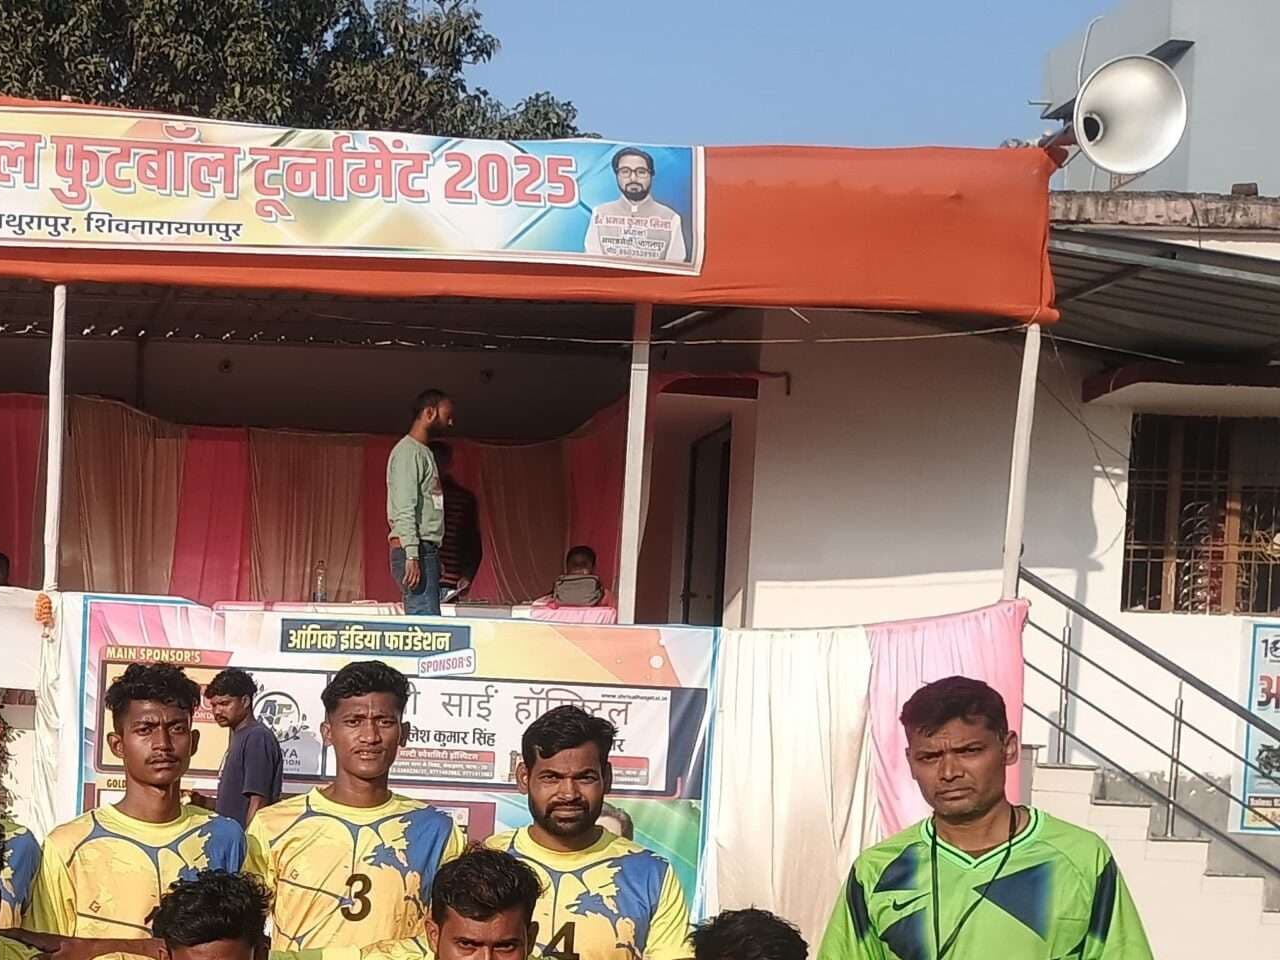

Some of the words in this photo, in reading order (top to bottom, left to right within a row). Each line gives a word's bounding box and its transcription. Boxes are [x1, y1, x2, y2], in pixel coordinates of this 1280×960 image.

[50, 124, 242, 206] फुटबॉल
[249, 134, 431, 218] टूर्नामेंट
[443, 151, 577, 205] 2025
[84, 212, 244, 241] शिवनारायणपुर
[288, 625, 337, 649] आंगिक
[338, 625, 382, 651] इंडिया
[384, 626, 452, 652] फाउंडेशन
[106, 646, 137, 661] MAIN
[139, 648, 202, 663] SPONSOR'S
[420, 655, 473, 674] SPONSOR'S
[440, 684, 499, 722] साईं
[433, 729, 469, 747] कुमार
[472, 727, 497, 747] सिंह
[340, 873, 372, 922] 3
